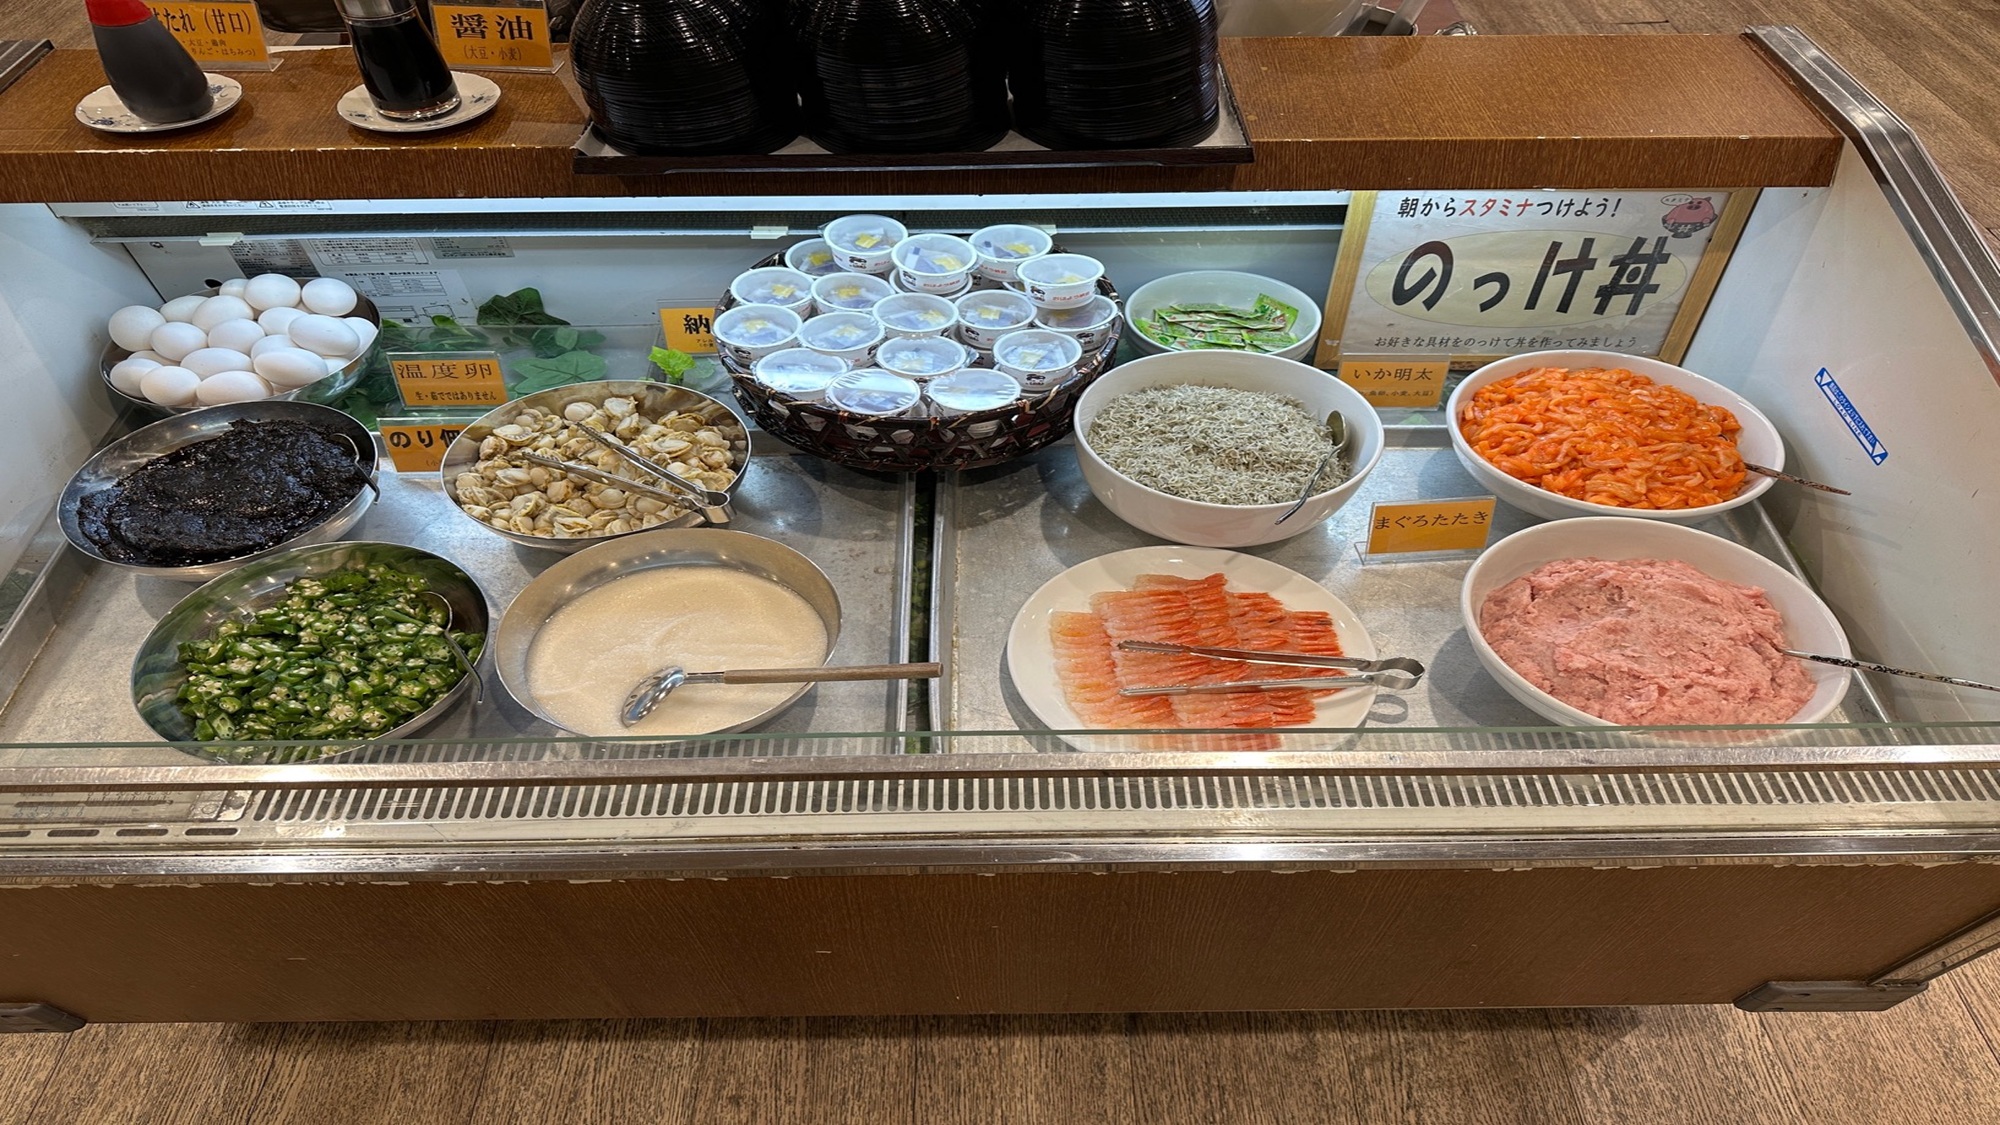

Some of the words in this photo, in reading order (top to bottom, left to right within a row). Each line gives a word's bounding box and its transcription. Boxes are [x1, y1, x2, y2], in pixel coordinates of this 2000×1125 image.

[451, 13, 533, 40] 醤油
[1397, 197, 1622, 218] 朝からスタミナつけよう！
[1391, 236, 1672, 316] のっけ丼
[1374, 336, 1637, 348] お好きな具材をのっけて丼を作ってみましょう
[398, 363, 492, 379] 温度卵
[1353, 368, 1433, 381] いか明太
[1375, 511, 1488, 530] まぐろたたき
